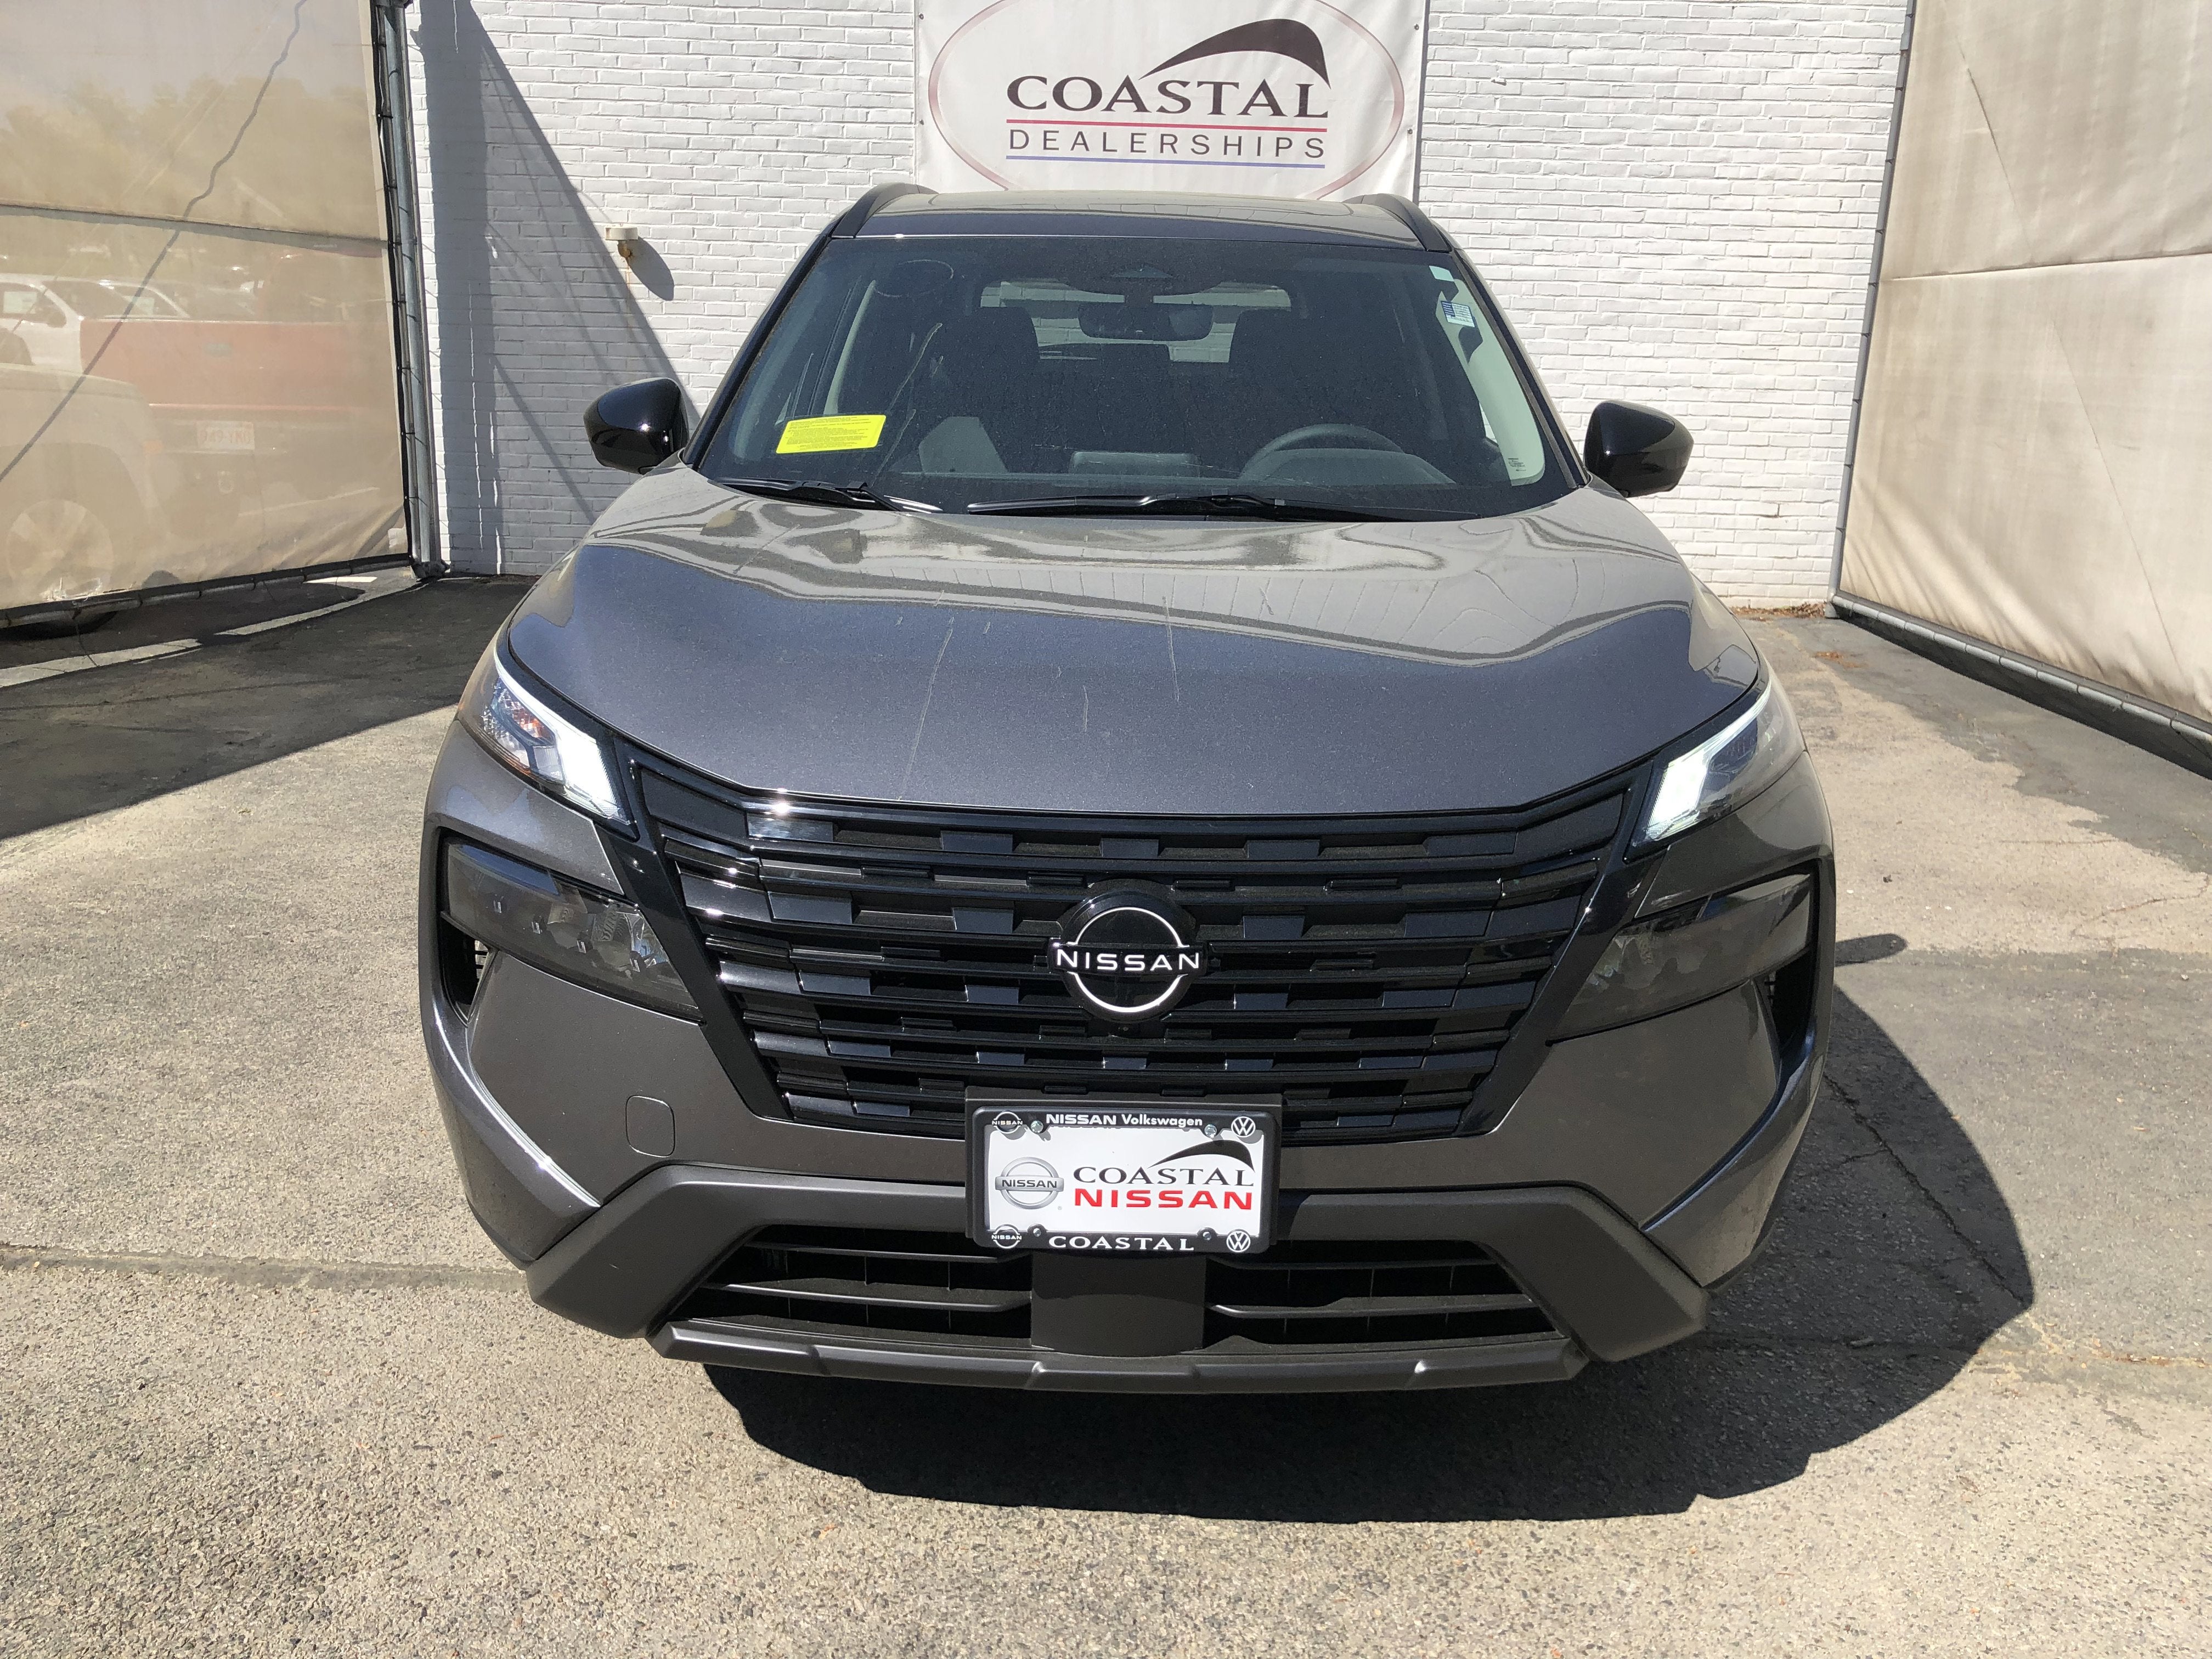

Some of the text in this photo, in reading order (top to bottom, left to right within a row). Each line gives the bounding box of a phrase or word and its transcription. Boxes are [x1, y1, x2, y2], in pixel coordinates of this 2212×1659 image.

[1007, 74, 1329, 119] COASTAL
[1009, 129, 1324, 159] DEALERSHIPS
[1057, 949, 1199, 971] NISSAN
[1046, 1114, 1203, 1128] NISSAN Volkswagen
[1002, 1180, 1057, 1188] NISSAN
[1073, 1166, 1254, 1187] COASTAL
[1075, 1188, 1252, 1210] NISSAN
[1048, 1235, 1194, 1251] COASTAL
